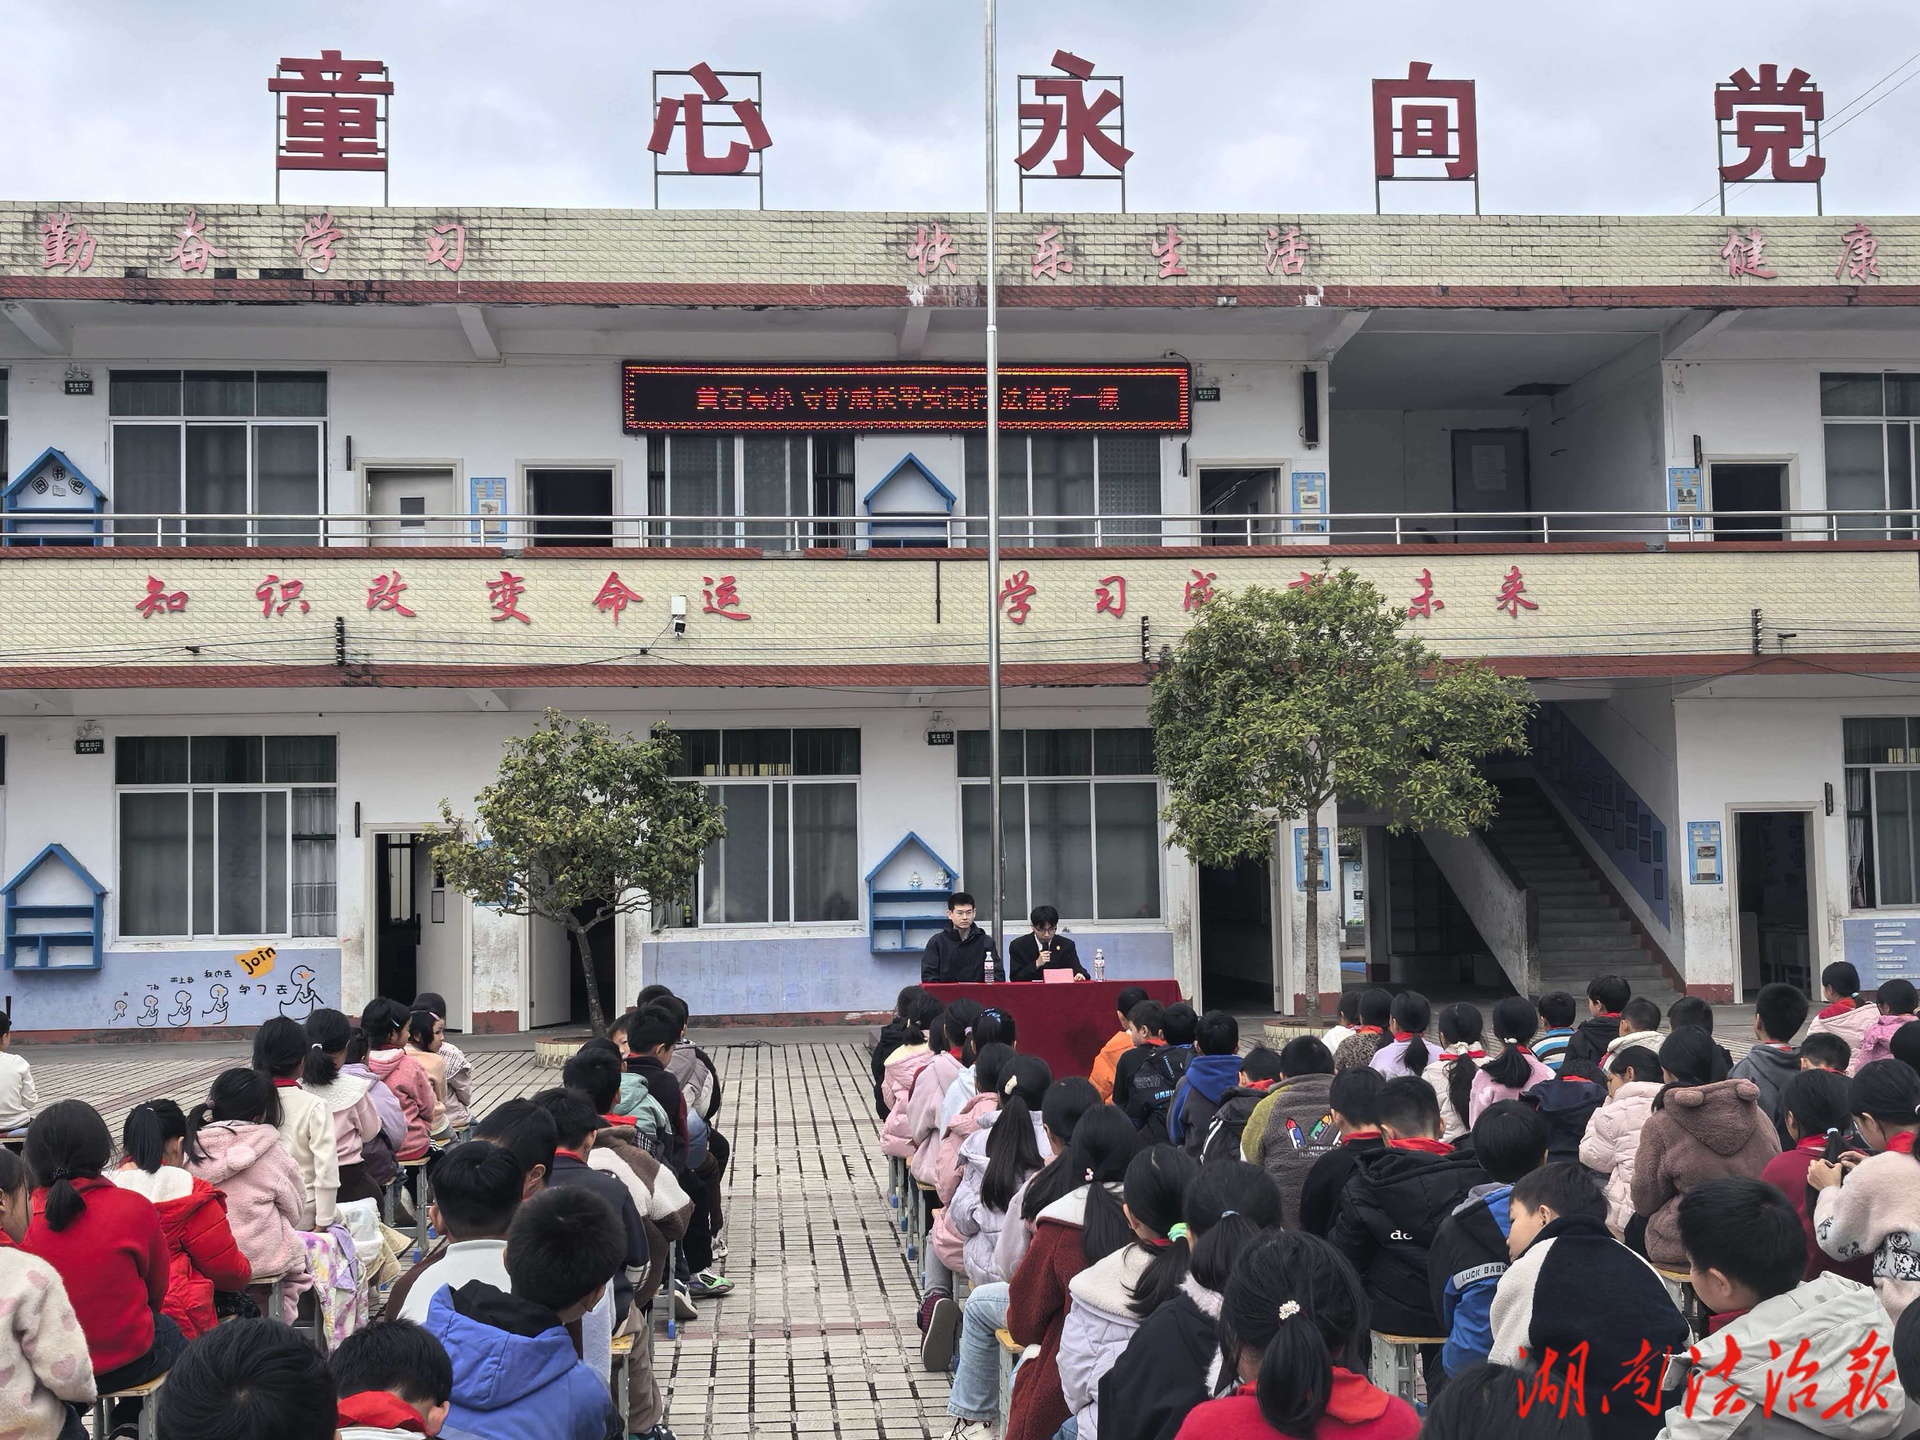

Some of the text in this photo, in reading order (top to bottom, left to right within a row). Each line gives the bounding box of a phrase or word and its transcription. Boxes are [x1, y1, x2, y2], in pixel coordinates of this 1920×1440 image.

[268, 49, 1826, 182] 童心永向党
[41, 209, 1882, 281] 勤奋学习 快乐生活 健康
[136, 570, 751, 625] 知识改变命运
[241, 947, 276, 975] join
[1461, 1268, 1480, 1282] LUCK
